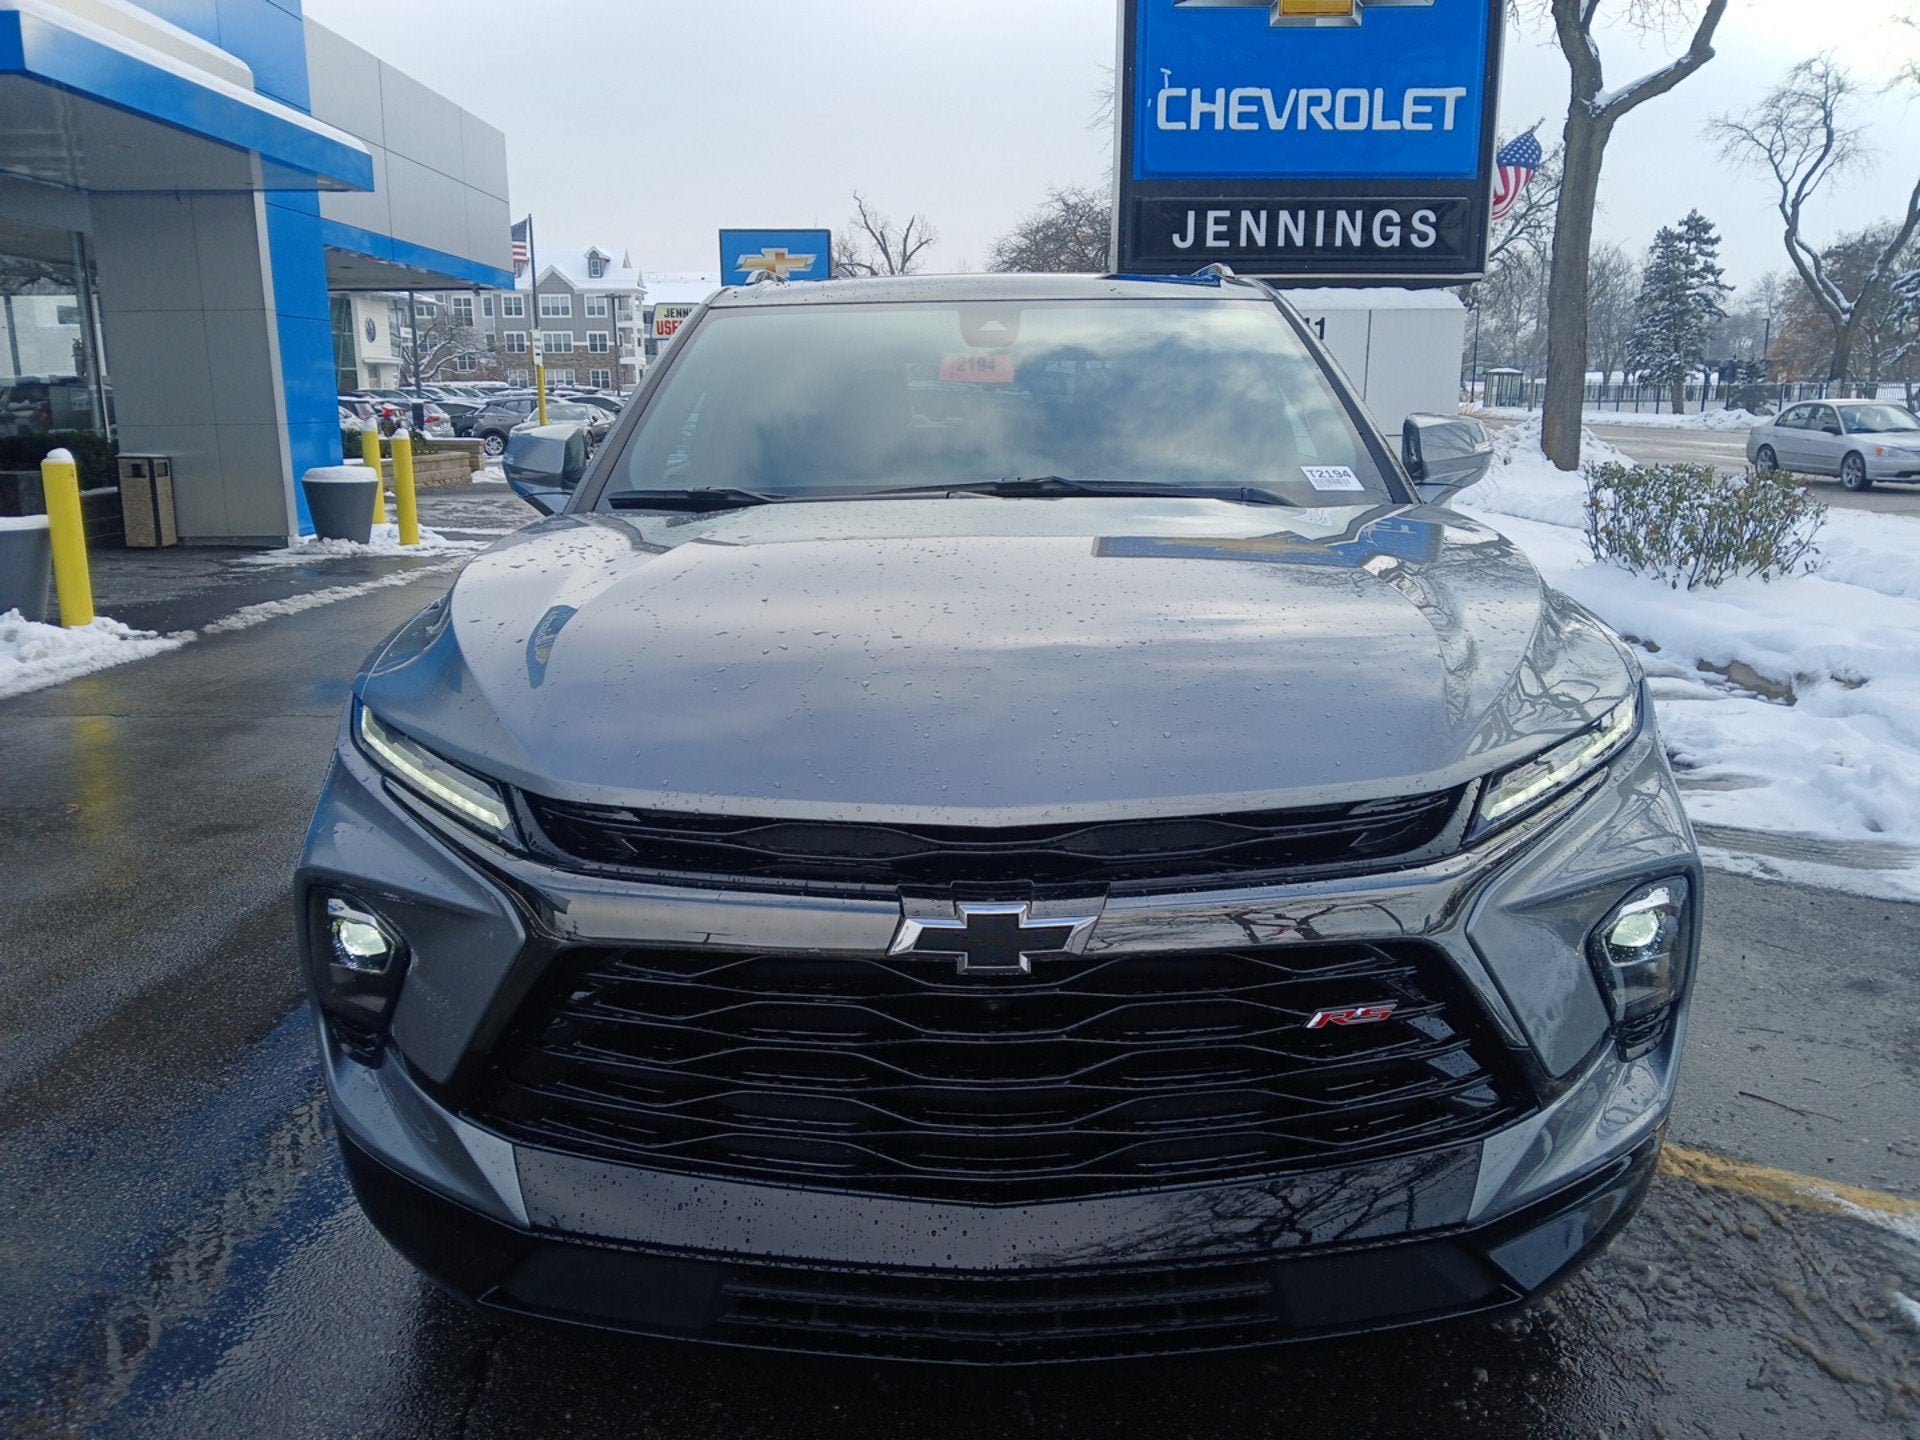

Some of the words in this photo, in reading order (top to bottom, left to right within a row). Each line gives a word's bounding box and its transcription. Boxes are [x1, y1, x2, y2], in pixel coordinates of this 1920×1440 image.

[1156, 87, 1467, 131] CHEVROLET
[1172, 209, 1438, 249] JENNINGS
[664, 307, 693, 318] JENN
[656, 319, 683, 336] USE
[1306, 469, 1351, 478] T2194
[1306, 1003, 1398, 1029] RS
